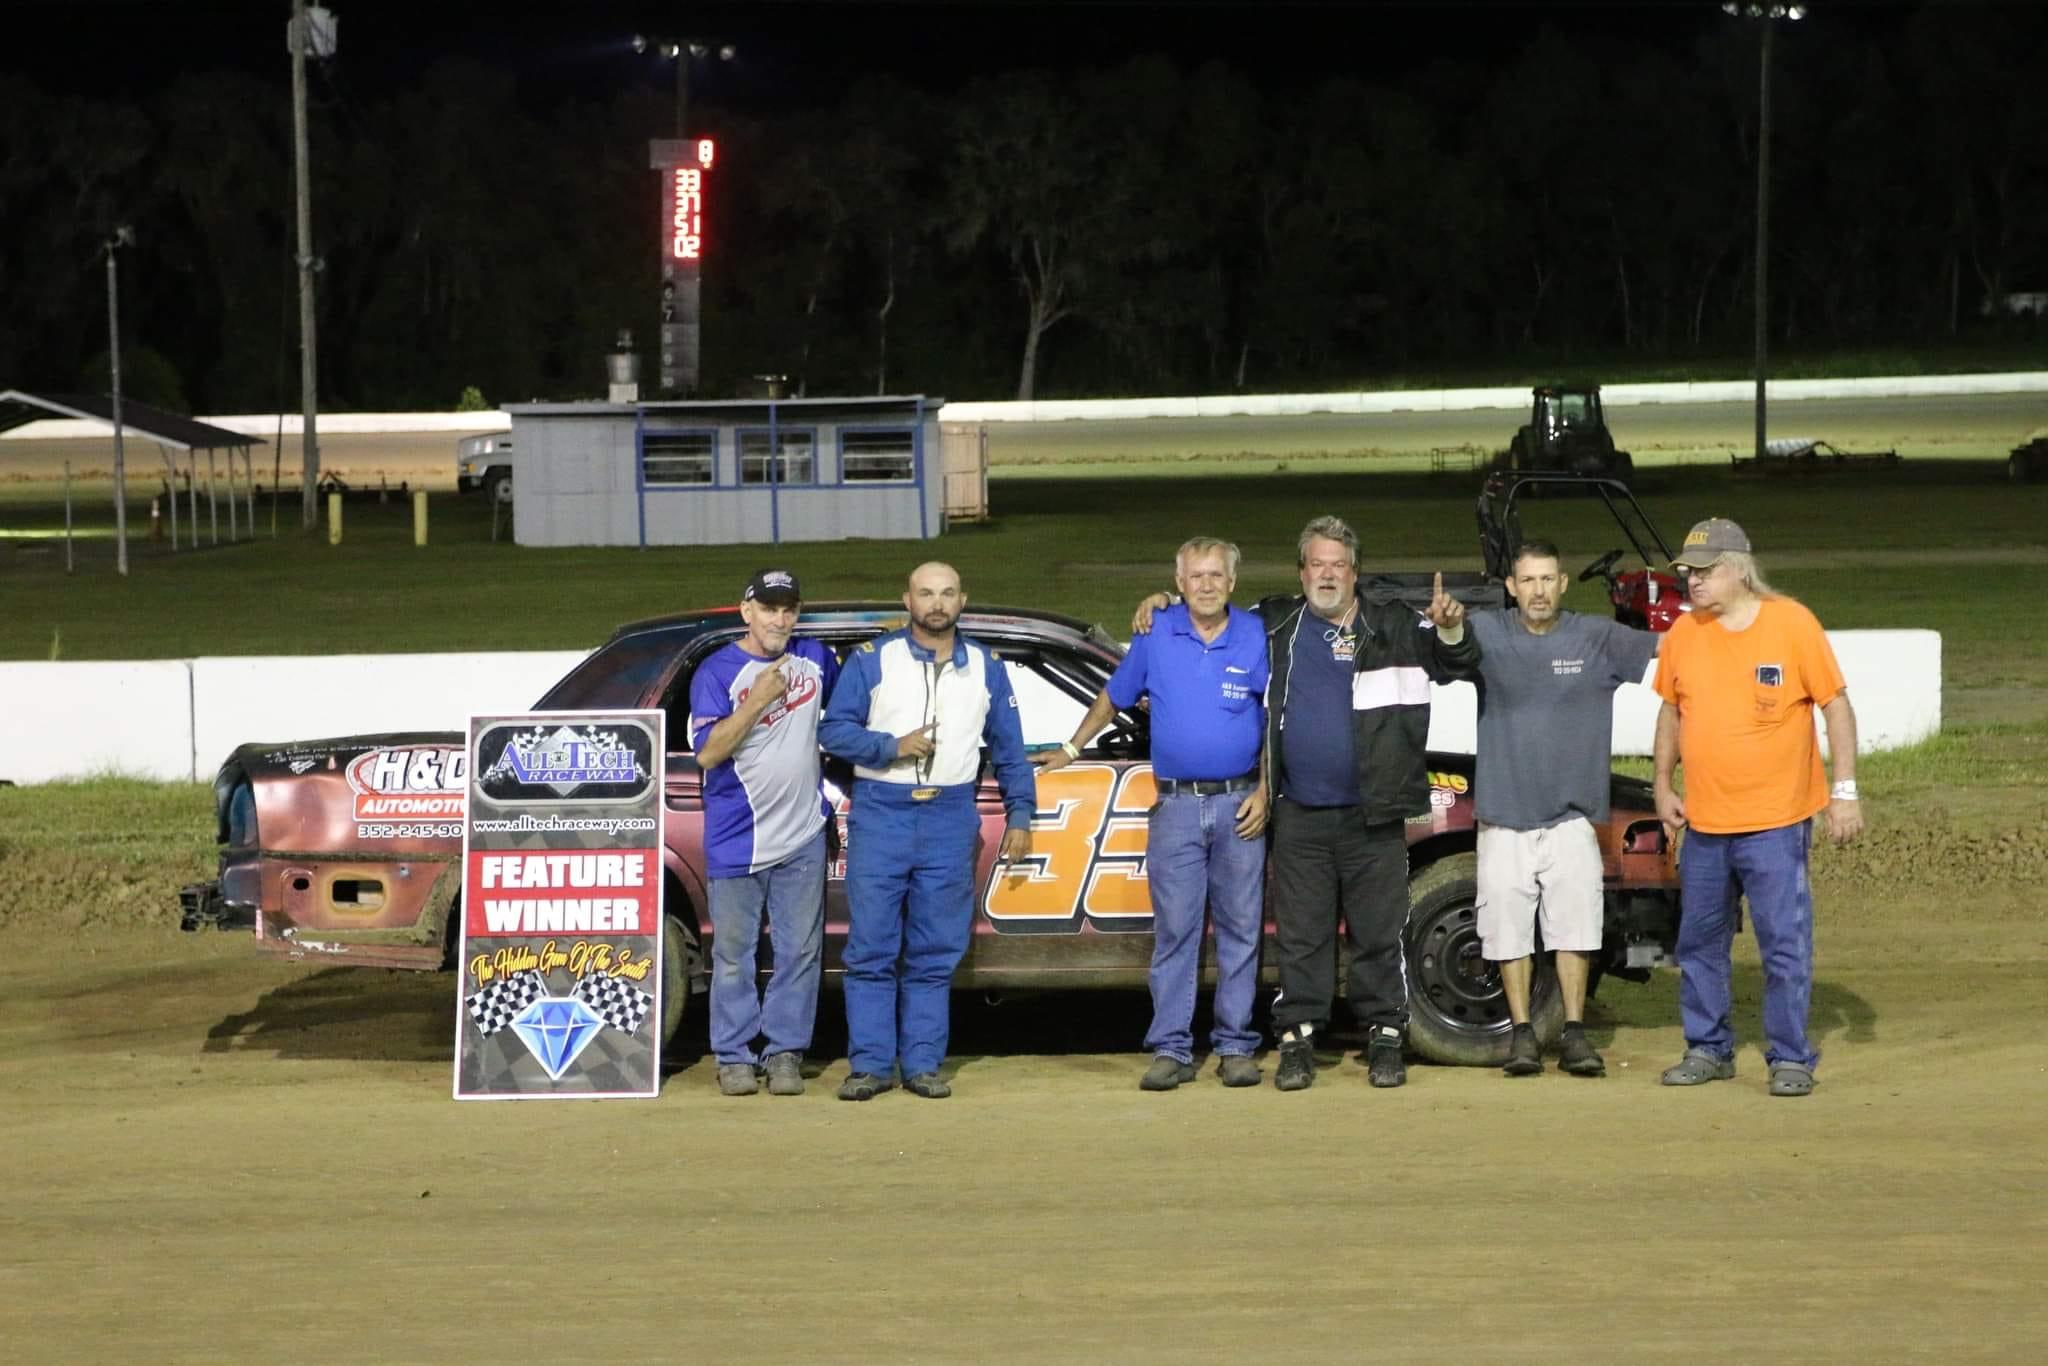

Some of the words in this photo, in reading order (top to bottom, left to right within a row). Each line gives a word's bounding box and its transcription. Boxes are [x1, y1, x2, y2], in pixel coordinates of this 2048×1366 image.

[675, 169, 700, 191] 33
[674, 214, 700, 235] 51
[527, 769, 628, 781] RACEWAY
[474, 815, 655, 835] www.alltechraceway.com
[481, 854, 644, 889] FEATURE
[484, 898, 640, 932] WINNER
[471, 953, 495, 987] The
[494, 946, 538, 979] Hidden
[539, 940, 569, 976] Gem
[569, 941, 591, 980] Of
[590, 943, 613, 972] The
[607, 950, 652, 981] South
